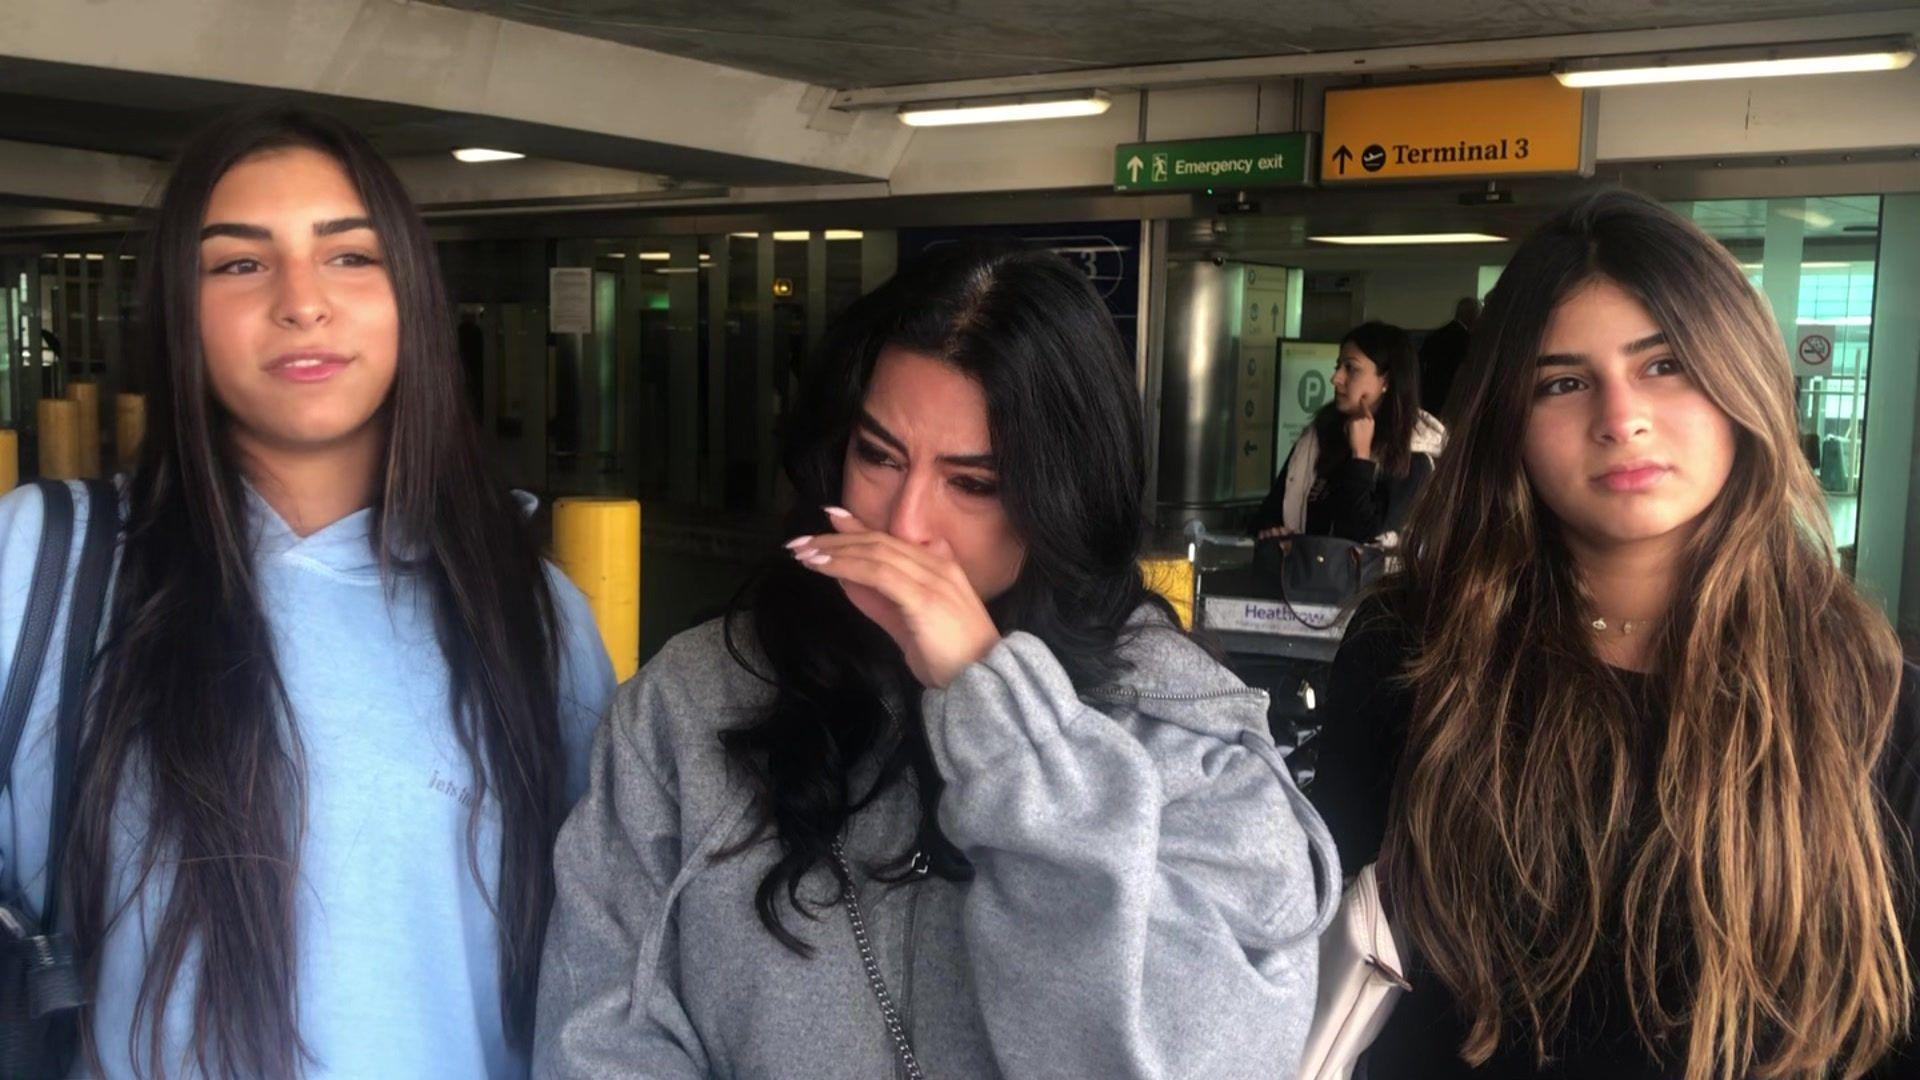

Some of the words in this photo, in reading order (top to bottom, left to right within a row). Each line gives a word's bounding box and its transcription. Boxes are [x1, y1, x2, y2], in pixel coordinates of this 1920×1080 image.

[1175, 158, 1253, 176] Emergency
[1258, 154, 1283, 170] exit
[1393, 139, 1508, 165] Terminal
[1514, 138, 1529, 160] 3
[1080, 250, 1098, 279] 3
